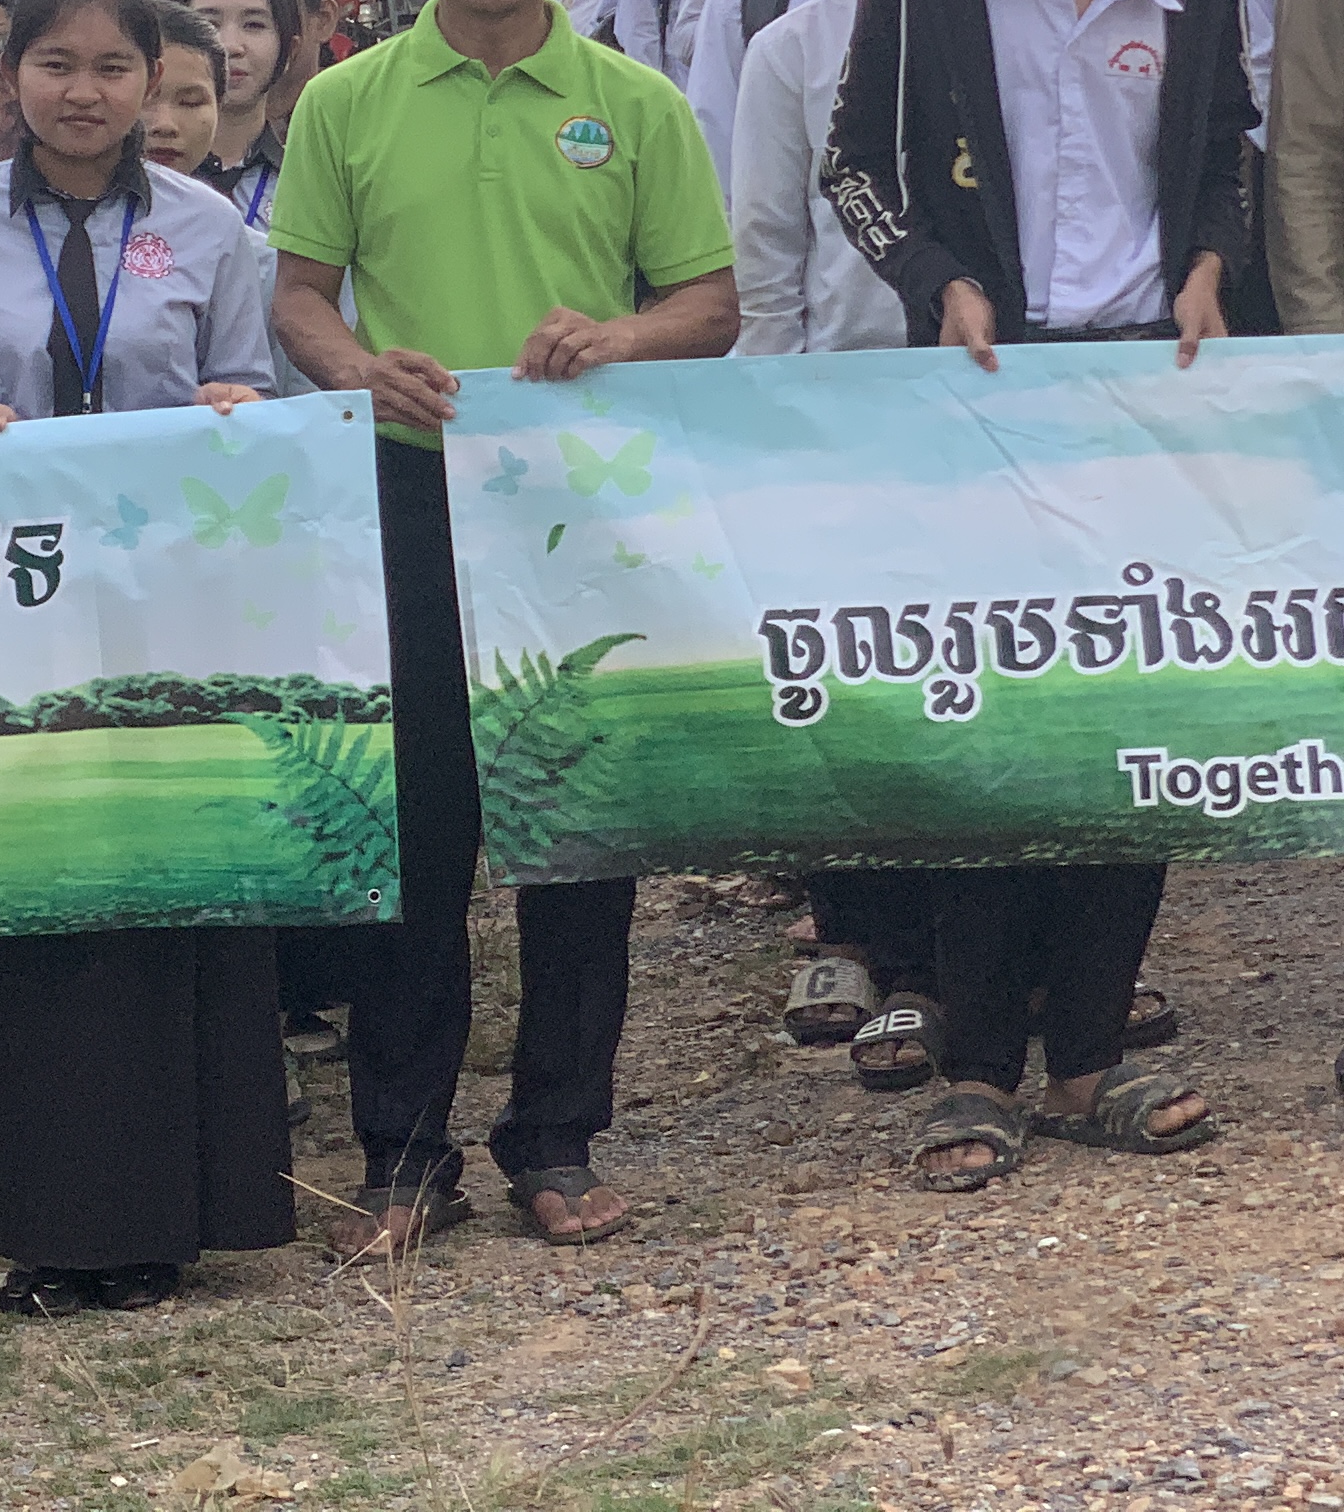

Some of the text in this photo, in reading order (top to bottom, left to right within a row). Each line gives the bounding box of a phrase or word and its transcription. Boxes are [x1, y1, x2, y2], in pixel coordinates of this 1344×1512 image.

[757, 561, 1344, 721] ចូលរួមទាំងអ
